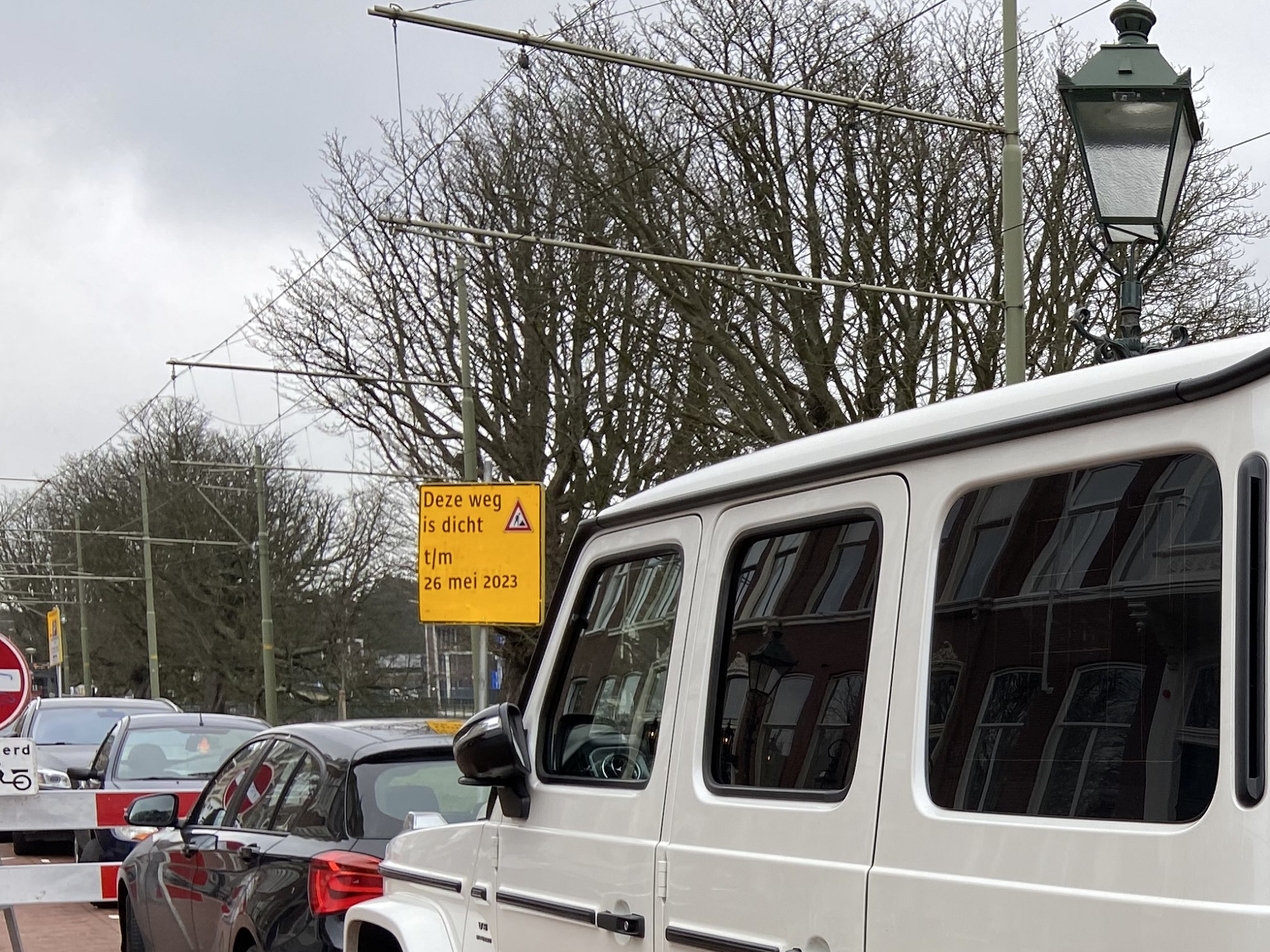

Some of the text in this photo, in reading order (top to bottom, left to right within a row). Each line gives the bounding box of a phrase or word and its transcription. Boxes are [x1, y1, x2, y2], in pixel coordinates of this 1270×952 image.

[424, 491, 502, 512] Deze weg
[423, 516, 483, 533] is dicht
[424, 548, 452, 570] t/m
[424, 571, 518, 590] 26 mei 2023
[2, 744, 30, 756] erd
